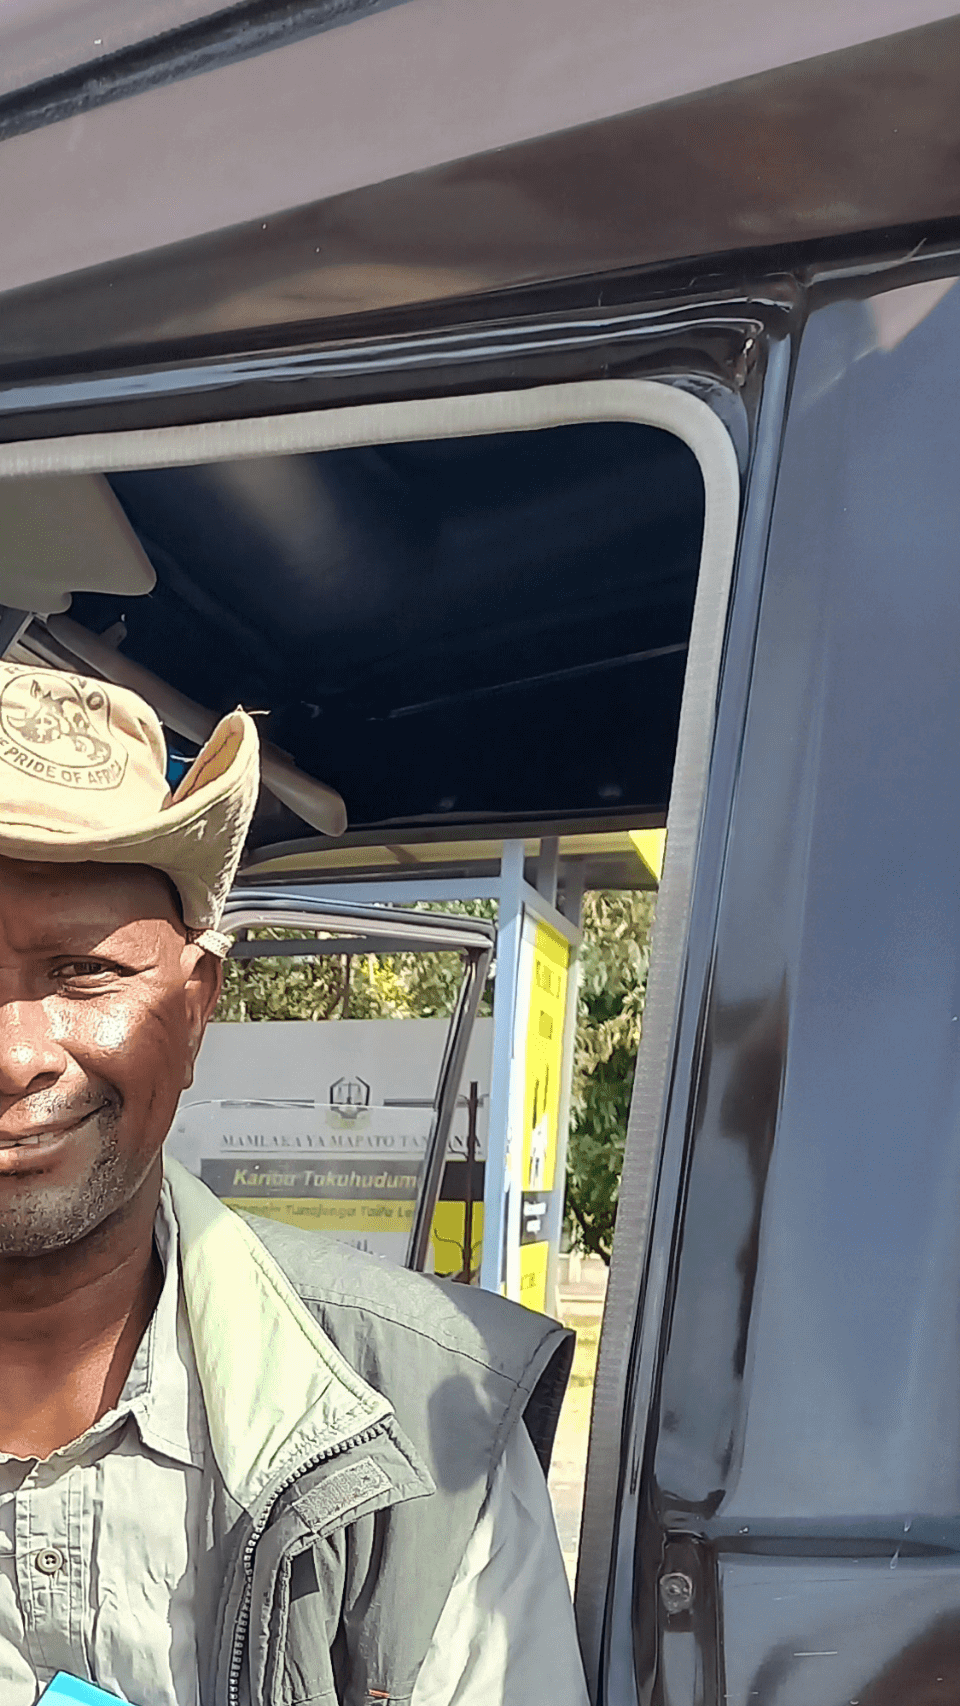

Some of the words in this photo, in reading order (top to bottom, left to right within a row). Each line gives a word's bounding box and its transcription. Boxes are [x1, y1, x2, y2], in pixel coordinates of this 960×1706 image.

[4, 745, 56, 779] PRIDE
[61, 771, 82, 784] OF
[329, 1134, 396, 1149] MAPATO
[302, 1169, 418, 1188] Tukuhudum
